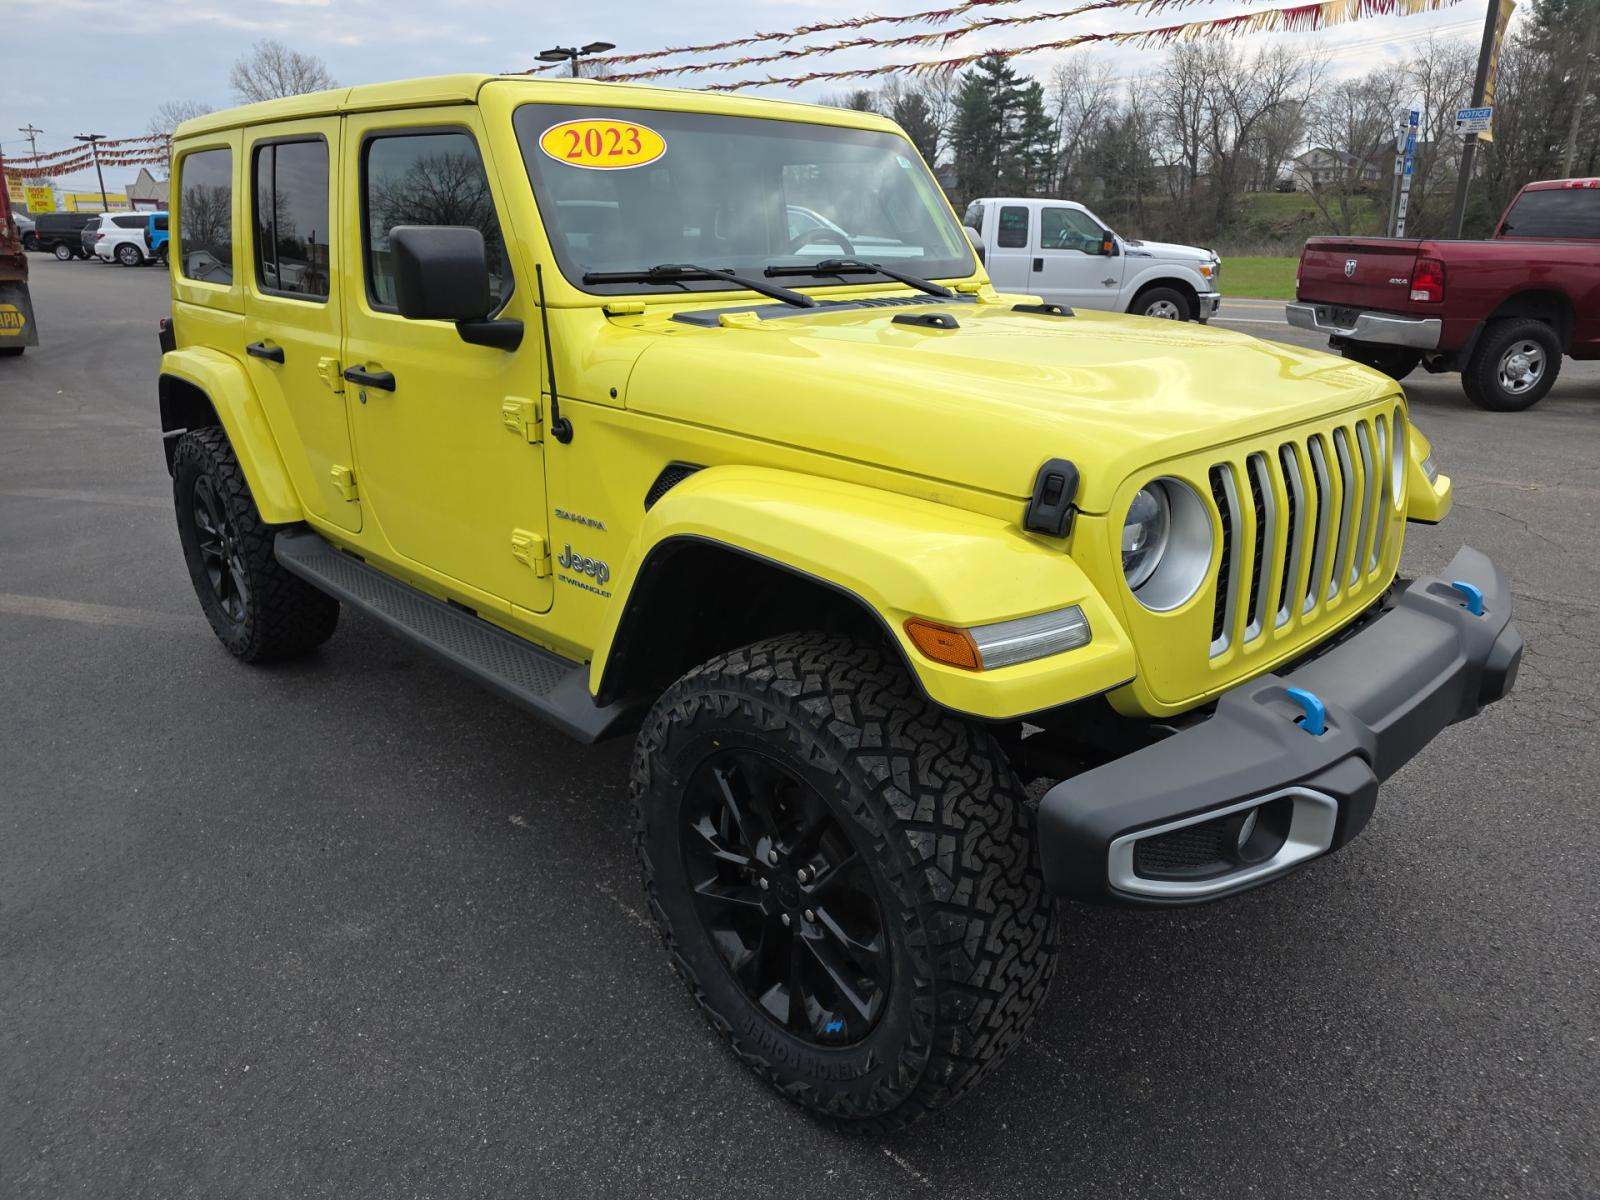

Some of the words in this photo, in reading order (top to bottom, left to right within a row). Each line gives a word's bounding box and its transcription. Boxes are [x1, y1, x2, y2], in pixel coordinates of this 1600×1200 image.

[1458, 109, 1489, 118] NOTICE
[564, 127, 642, 158] 2023
[0, 311, 18, 328] APA
[555, 508, 607, 531] SAHARA
[558, 543, 609, 585] Jeep
[566, 578, 612, 598] WRANGLER
